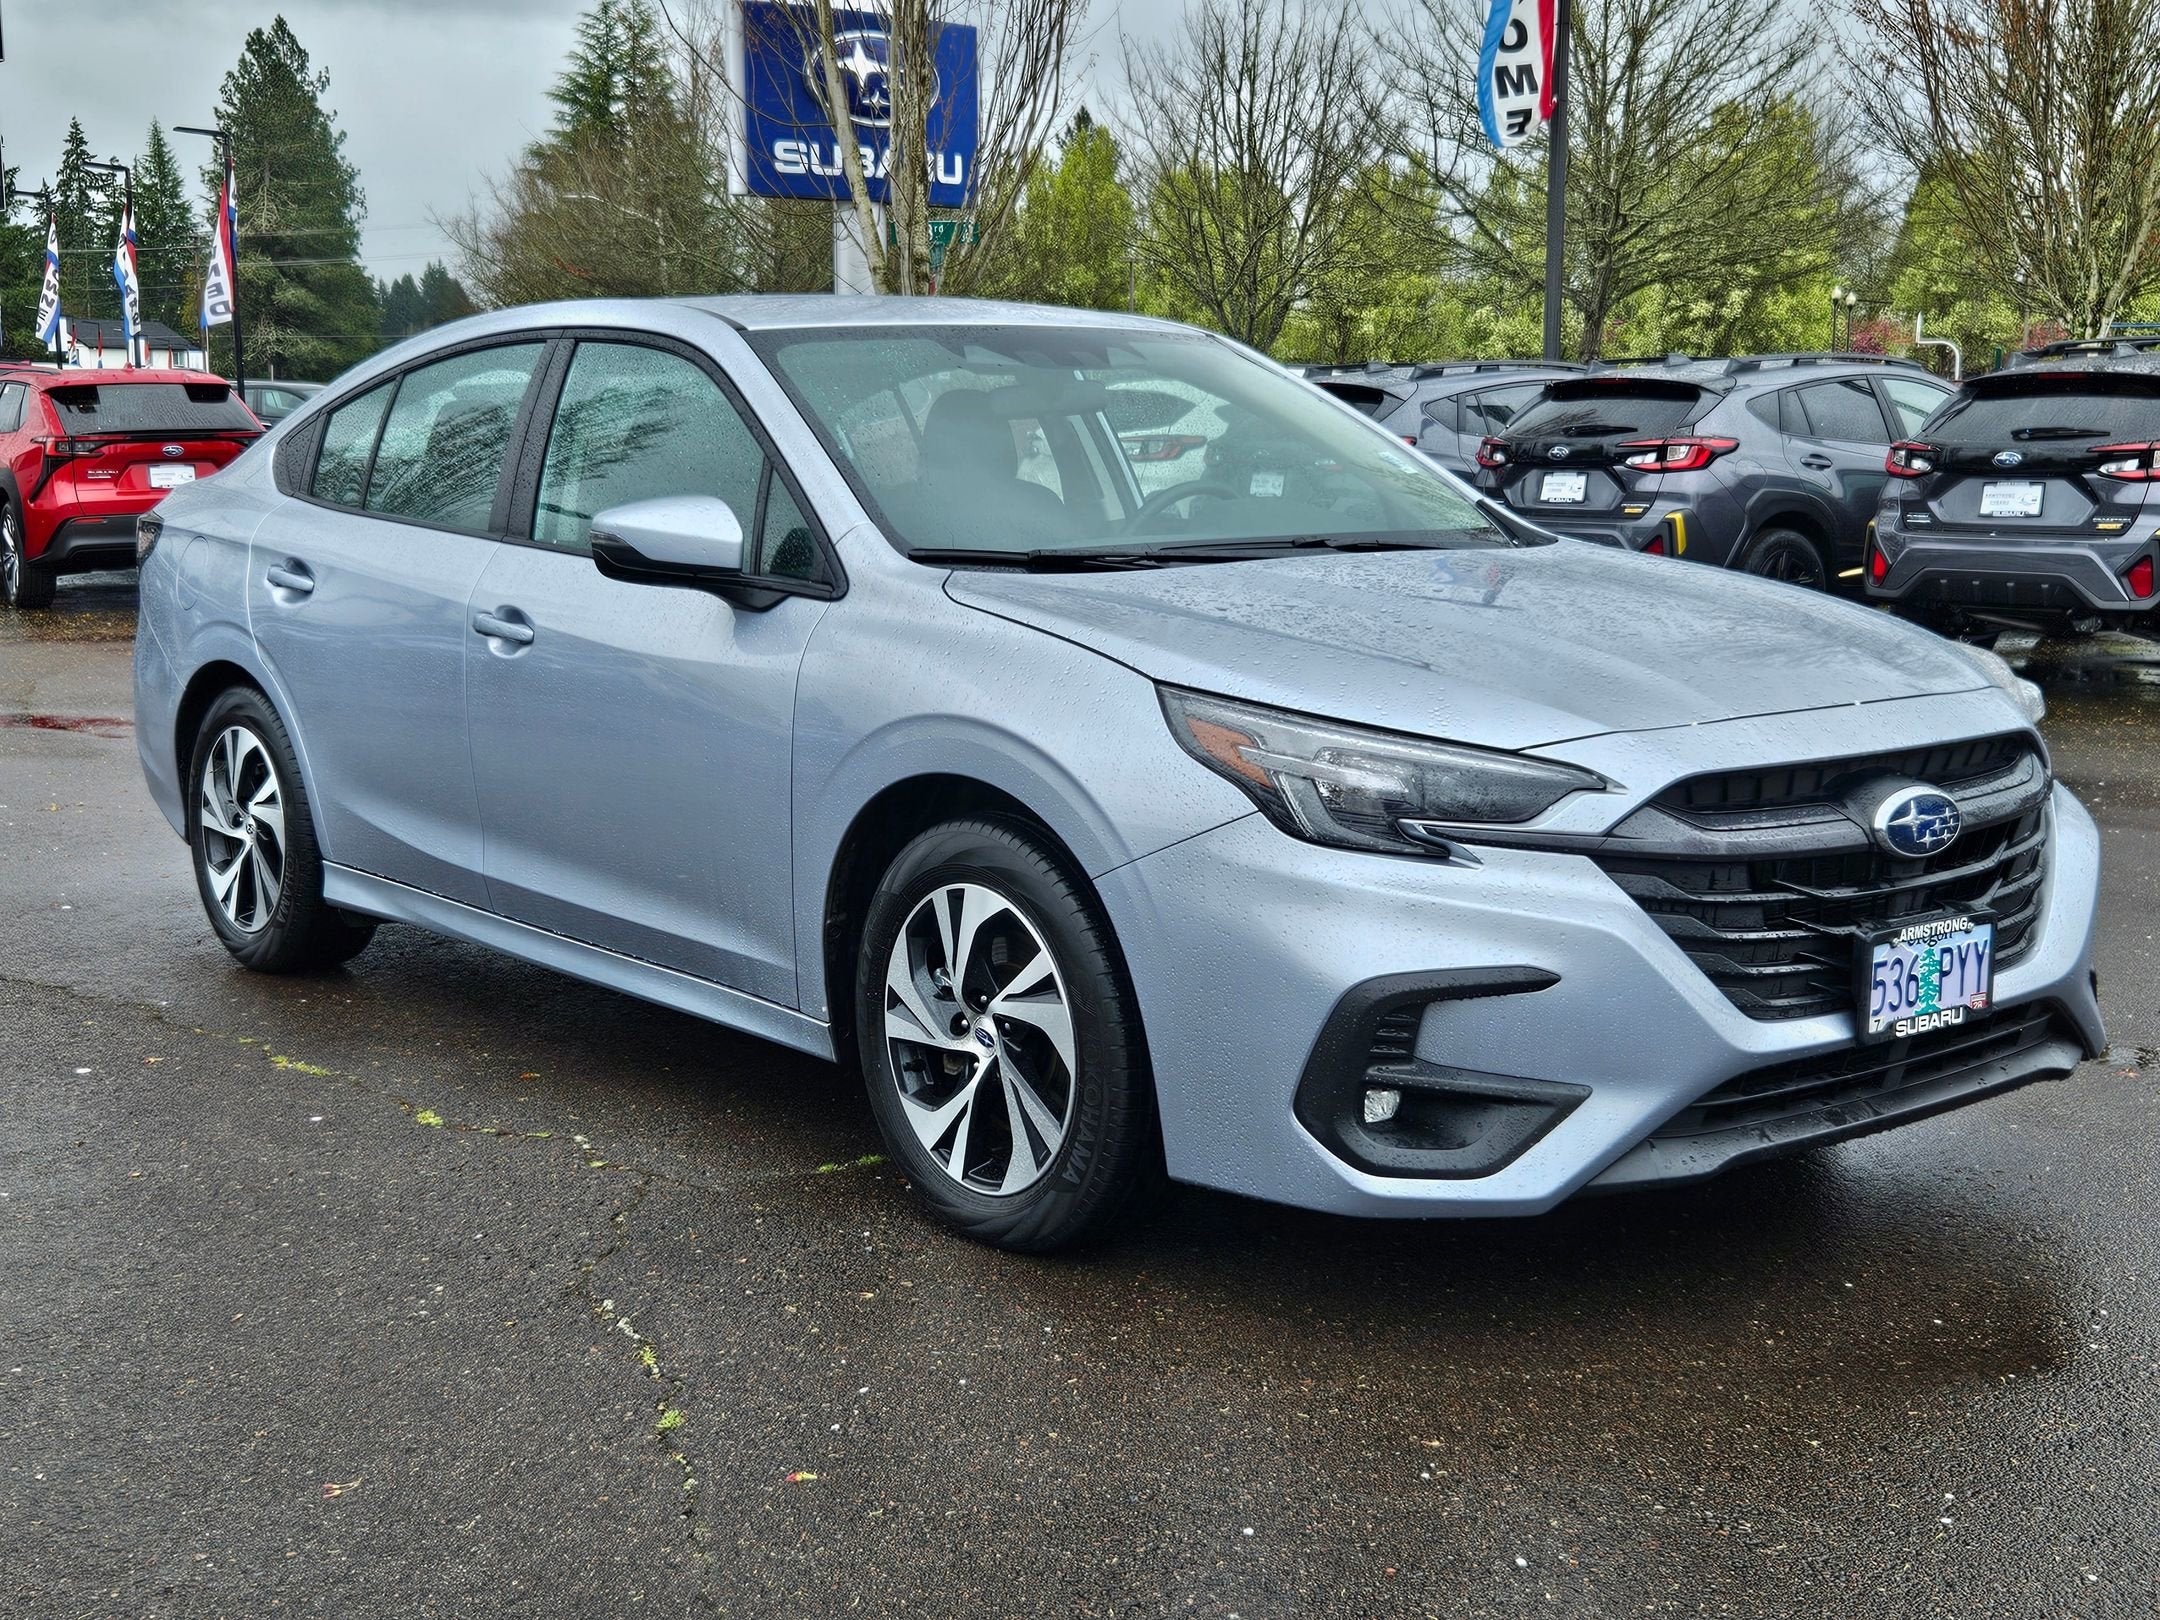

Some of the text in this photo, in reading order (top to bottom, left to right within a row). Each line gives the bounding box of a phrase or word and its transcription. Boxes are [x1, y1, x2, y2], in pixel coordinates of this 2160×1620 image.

[1900, 917, 1968, 941] ARMSTRONG
[1871, 939, 1989, 1017] 536 PYY
[1895, 1007, 1963, 1038] SUBARU
